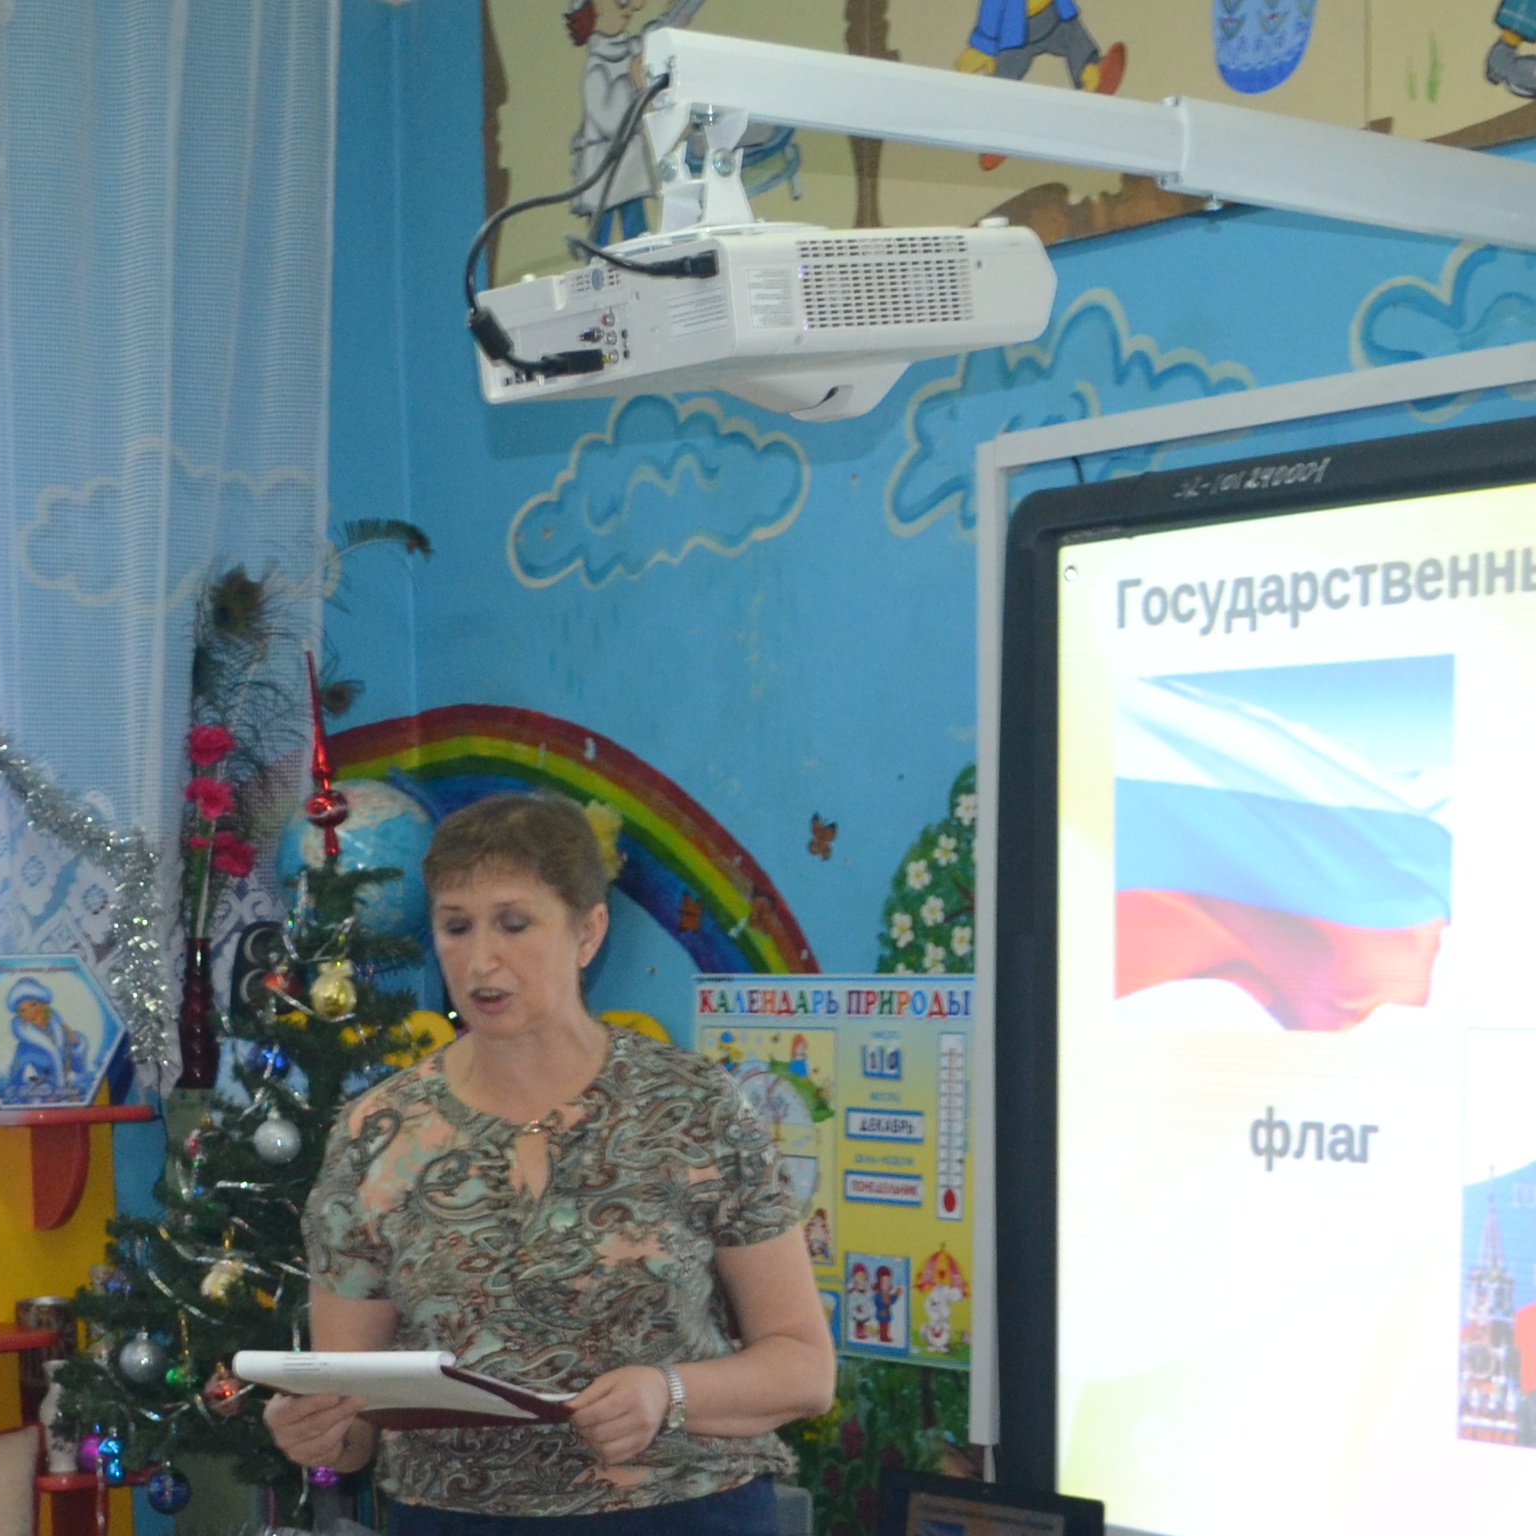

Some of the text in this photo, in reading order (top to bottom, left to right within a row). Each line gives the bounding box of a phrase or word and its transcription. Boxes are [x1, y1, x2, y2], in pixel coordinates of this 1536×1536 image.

[698, 988, 971, 1018] КАЛЕНДАРЬ ПРИРОДЫ
[859, 1117, 916, 1134] ДЕКАБРЬ
[1249, 1107, 1380, 1170] флаг
